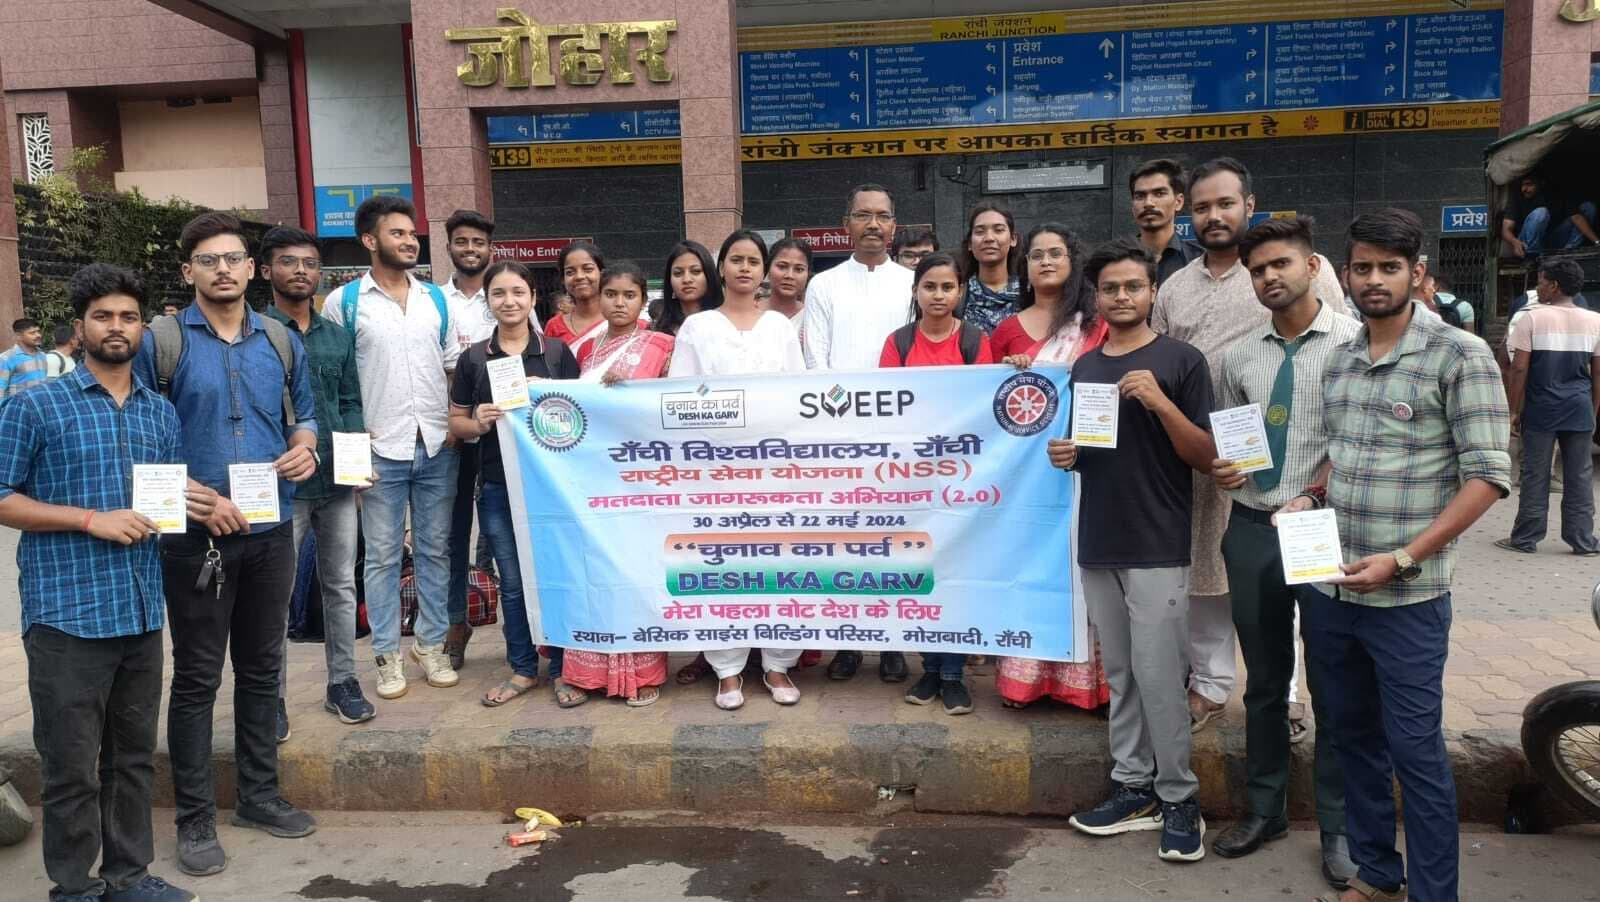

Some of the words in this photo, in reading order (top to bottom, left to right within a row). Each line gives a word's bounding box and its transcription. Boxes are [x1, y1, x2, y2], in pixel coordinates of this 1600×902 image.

[940, 30, 989, 40] RANCHI
[992, 25, 1057, 37] JUNCTION
[965, 17, 988, 29] रांची
[445, 7, 678, 88] जोहार
[1013, 38, 1043, 54] प्रवेश
[1012, 55, 1065, 67] Entrance
[1367, 119, 1390, 129] DIAL
[1391, 109, 1428, 128] 139
[1432, 118, 1467, 127] Departure
[1470, 118, 1478, 126] of
[741, 138, 800, 159] रांची
[913, 136, 947, 151] पर
[957, 132, 1053, 150] आपका
[1061, 123, 1145, 146] हार्दिक
[1155, 122, 1251, 142] स्वागत
[1260, 115, 1279, 137] है
[499, 148, 530, 166] 139
[1452, 208, 1488, 227] प्रवेश
[801, 232, 820, 247] वेश
[823, 232, 850, 247] निषेध
[519, 248, 534, 257] No
[537, 246, 562, 257] Entr
[664, 400, 698, 416] चुनाव
[701, 399, 719, 410] का
[722, 393, 741, 409] पर्व
[799, 389, 915, 419] SWEEP
[678, 411, 700, 421] DESH
[701, 411, 714, 420] KA
[714, 410, 739, 420] GARV
[608, 440, 673, 463] राँची
[680, 438, 901, 461] विश्वविद्यालय,
[913, 434, 984, 458] राँची
[619, 464, 703, 487] राष्ट्रीय
[708, 465, 764, 481] सेवा
[769, 463, 864, 480] योजना
[874, 459, 973, 483] (NSS)
[587, 493, 681, 508] मतदाता
[686, 490, 824, 505] जागरूकता
[829, 486, 934, 504] अभियान
[942, 484, 1001, 506] (2.0)
[692, 516, 713, 528] 30
[717, 511, 772, 530] अप्रैल
[776, 512, 795, 527] से
[800, 515, 821, 527] 22
[826, 511, 860, 528] मई
[865, 514, 906, 526] 2024
[791, 541, 836, 558] का
[844, 536, 893, 558] पर्व
[678, 571, 765, 592] DESH
[776, 571, 823, 591] KA
[832, 571, 926, 591] GARV
[662, 600, 702, 620] मेरा
[708, 603, 770, 619] पहला
[777, 597, 817, 619] वोट
[821, 598, 860, 619] देश
[864, 599, 891, 619] के
[897, 597, 943, 622] लिए
[694, 624, 748, 642] साइंस
[753, 624, 820, 642] बिल्डिंग
[825, 624, 890, 644] परिसर,
[995, 629, 1033, 649] राँची
